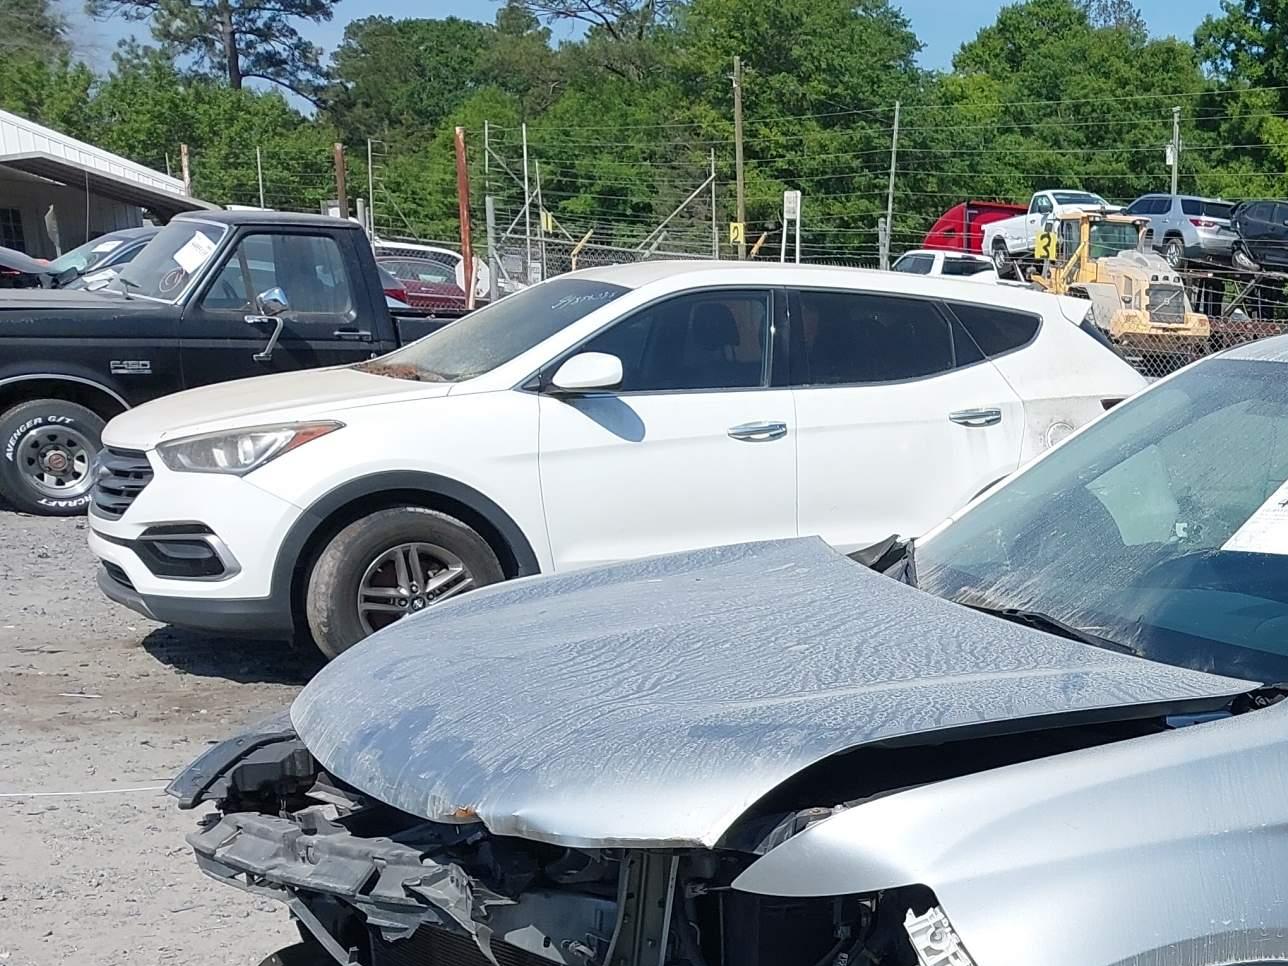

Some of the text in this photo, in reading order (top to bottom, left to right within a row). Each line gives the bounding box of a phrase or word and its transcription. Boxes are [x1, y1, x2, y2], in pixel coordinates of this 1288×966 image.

[732, 226, 741, 243] 2
[1039, 232, 1052, 259] 3
[5, 415, 75, 462] AVENGER G/T
